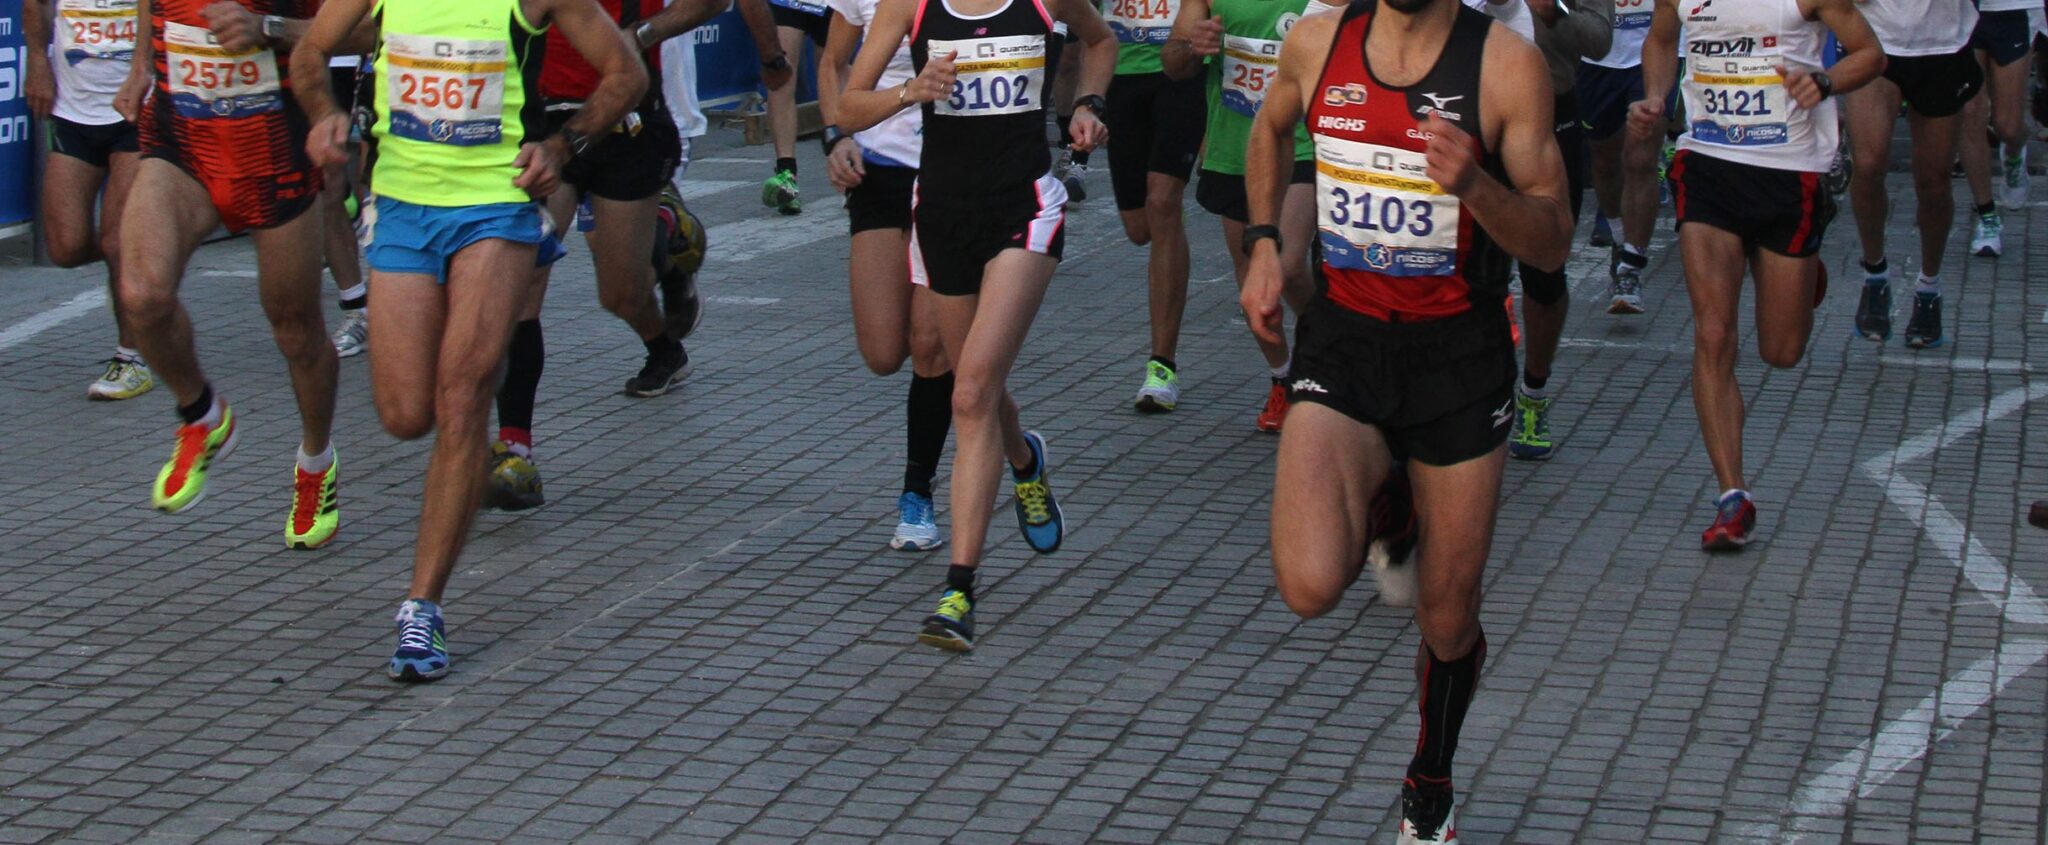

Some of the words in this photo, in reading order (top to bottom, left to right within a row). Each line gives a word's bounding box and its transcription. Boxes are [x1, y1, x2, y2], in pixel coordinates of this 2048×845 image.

[1112, 0, 1170, 20] 2614
[73, 20, 136, 44] 2544
[1689, 36, 1756, 57] zipvit
[179, 59, 260, 90] 2579
[399, 73, 487, 111] 2567
[948, 74, 1030, 111] 3102
[1703, 88, 1772, 116] 3121
[1405, 128, 1434, 141] GAR
[1330, 187, 1434, 237] 3103
